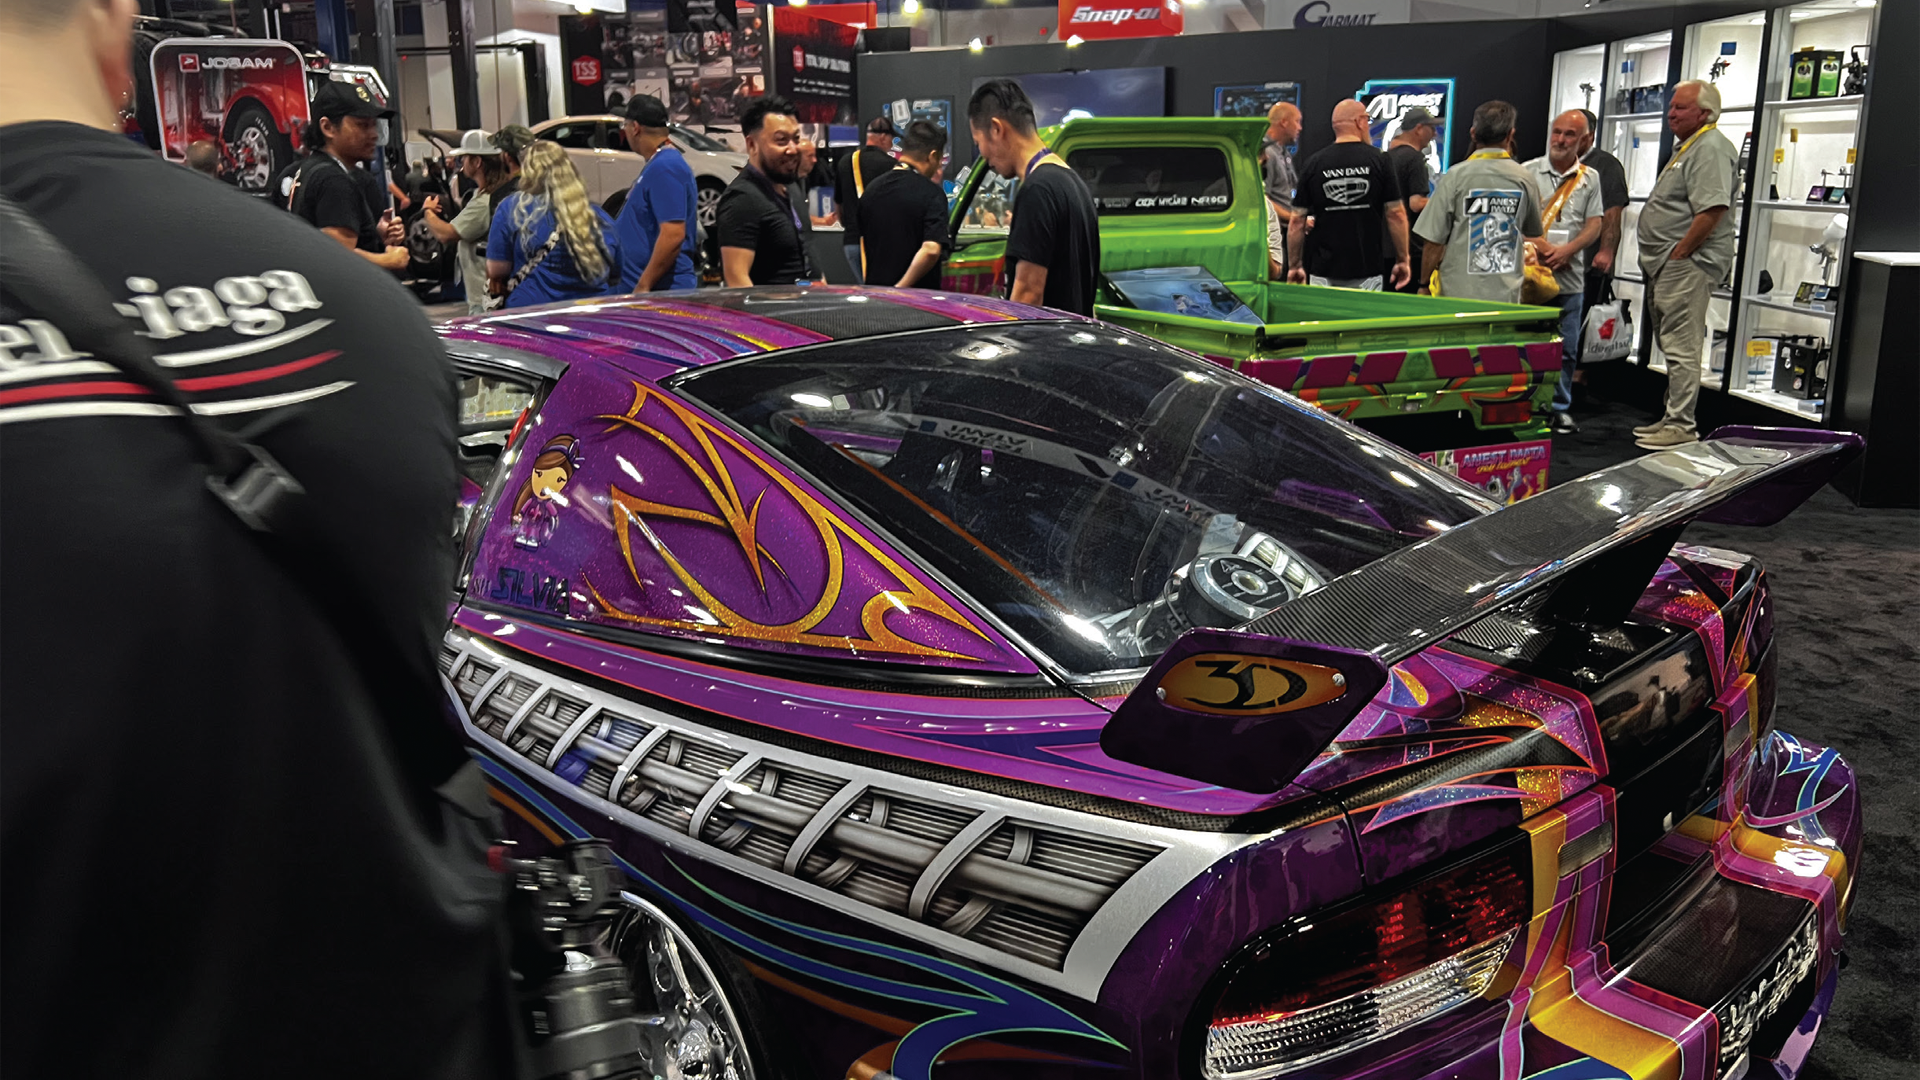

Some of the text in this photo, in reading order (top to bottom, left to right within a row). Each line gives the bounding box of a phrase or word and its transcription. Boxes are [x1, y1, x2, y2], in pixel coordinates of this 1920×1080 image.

[1293, 1, 1377, 28] GARMAT
[202, 57, 274, 69] JOSAM
[575, 61, 597, 77] TSS
[1322, 166, 1370, 178] VAN DAM
[1462, 450, 1507, 468] ANEST
